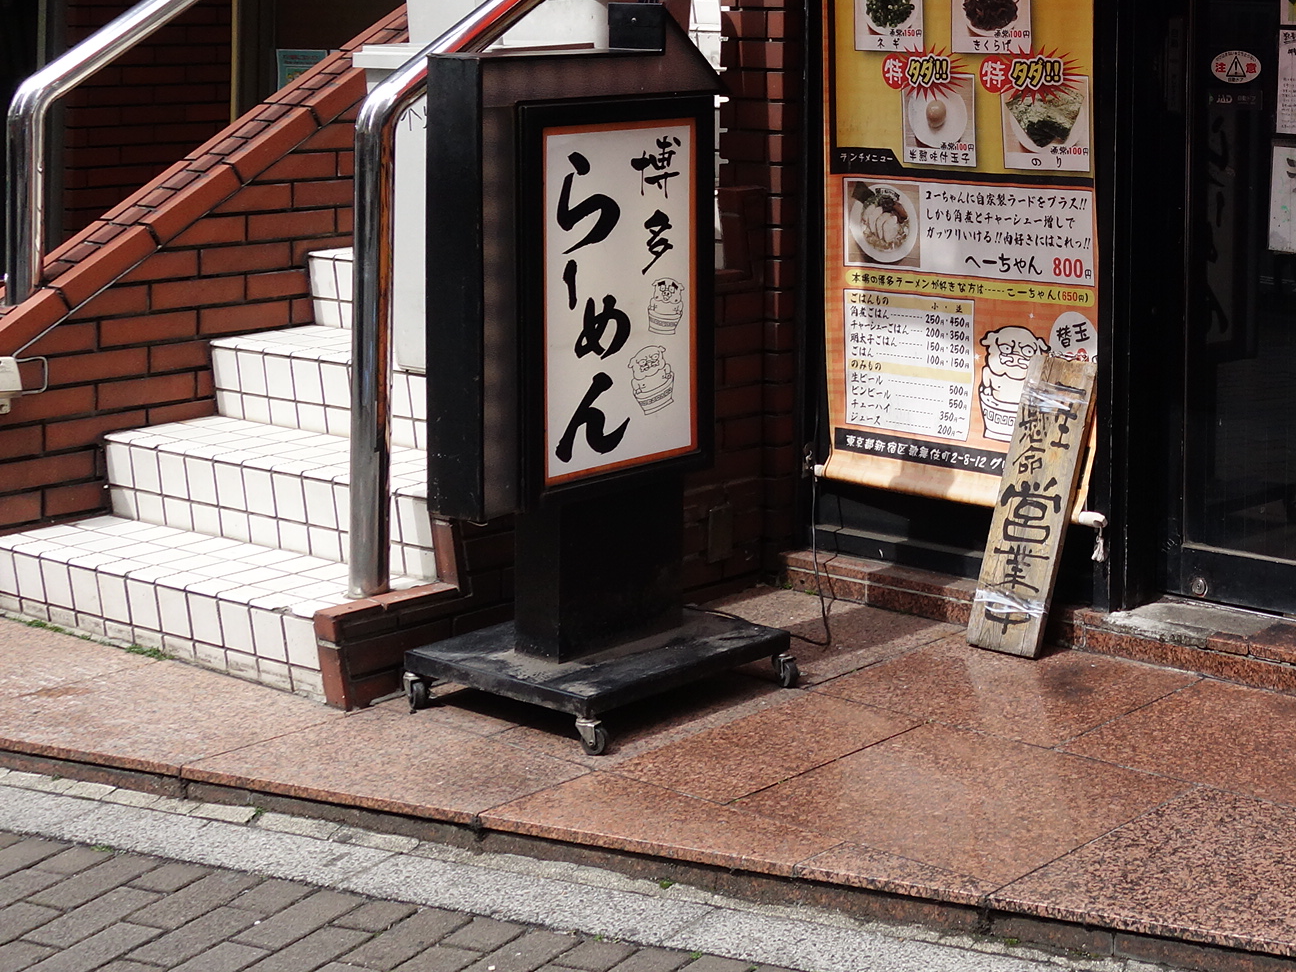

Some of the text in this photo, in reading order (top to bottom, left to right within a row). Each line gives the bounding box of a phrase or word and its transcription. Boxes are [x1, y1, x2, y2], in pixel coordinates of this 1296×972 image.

[972, 38, 1012, 52] きくらげ
[885, 55, 949, 84] 特 タダ!!
[981, 58, 1061, 86] 特 タダ!!
[1215, 62, 1227, 73] 注
[840, 152, 894, 163] ランチメニュー
[1031, 156, 1063, 168] のり
[630, 135, 682, 276] 博多
[1053, 257, 1092, 279] 800円
[850, 293, 889, 306] ごはんもの
[555, 151, 632, 463] らーめん
[850, 305, 889, 319] 角煮ごはん
[850, 319, 909, 335] チャーシューごはん
[850, 333, 897, 347] 明太子ごはん
[1056, 322, 1091, 349] 替玉
[851, 346, 875, 358] ごはん
[851, 360, 882, 371] のみもの
[851, 372, 884, 385] 生ビール
